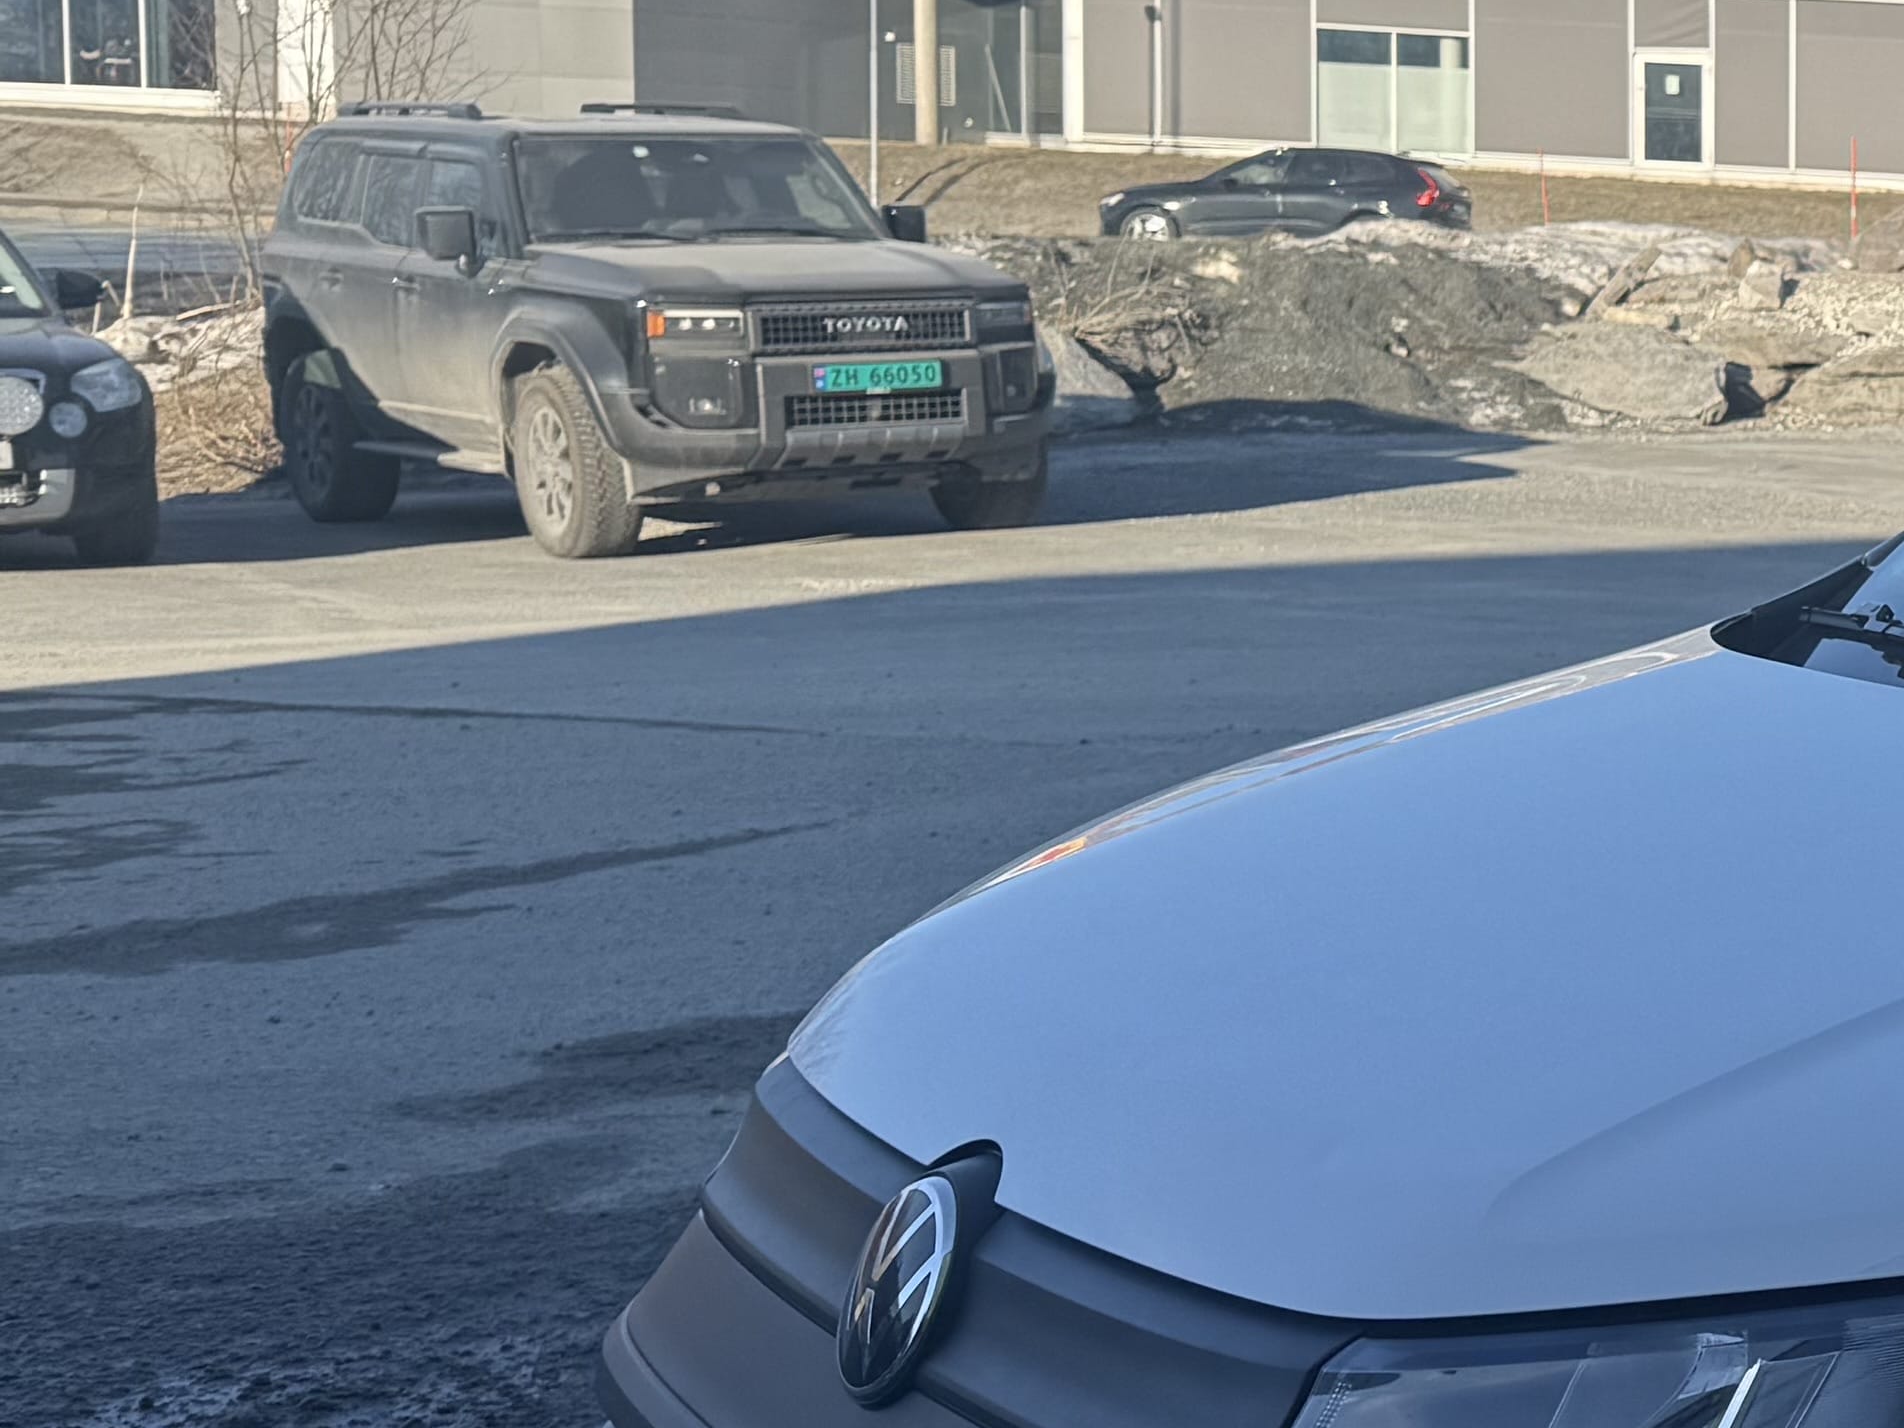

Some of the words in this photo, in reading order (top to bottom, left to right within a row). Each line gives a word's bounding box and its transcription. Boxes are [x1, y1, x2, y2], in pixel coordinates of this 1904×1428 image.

[823, 315, 909, 333] TOYOTA
[830, 368, 859, 387] ZH
[869, 363, 937, 387] 66050
